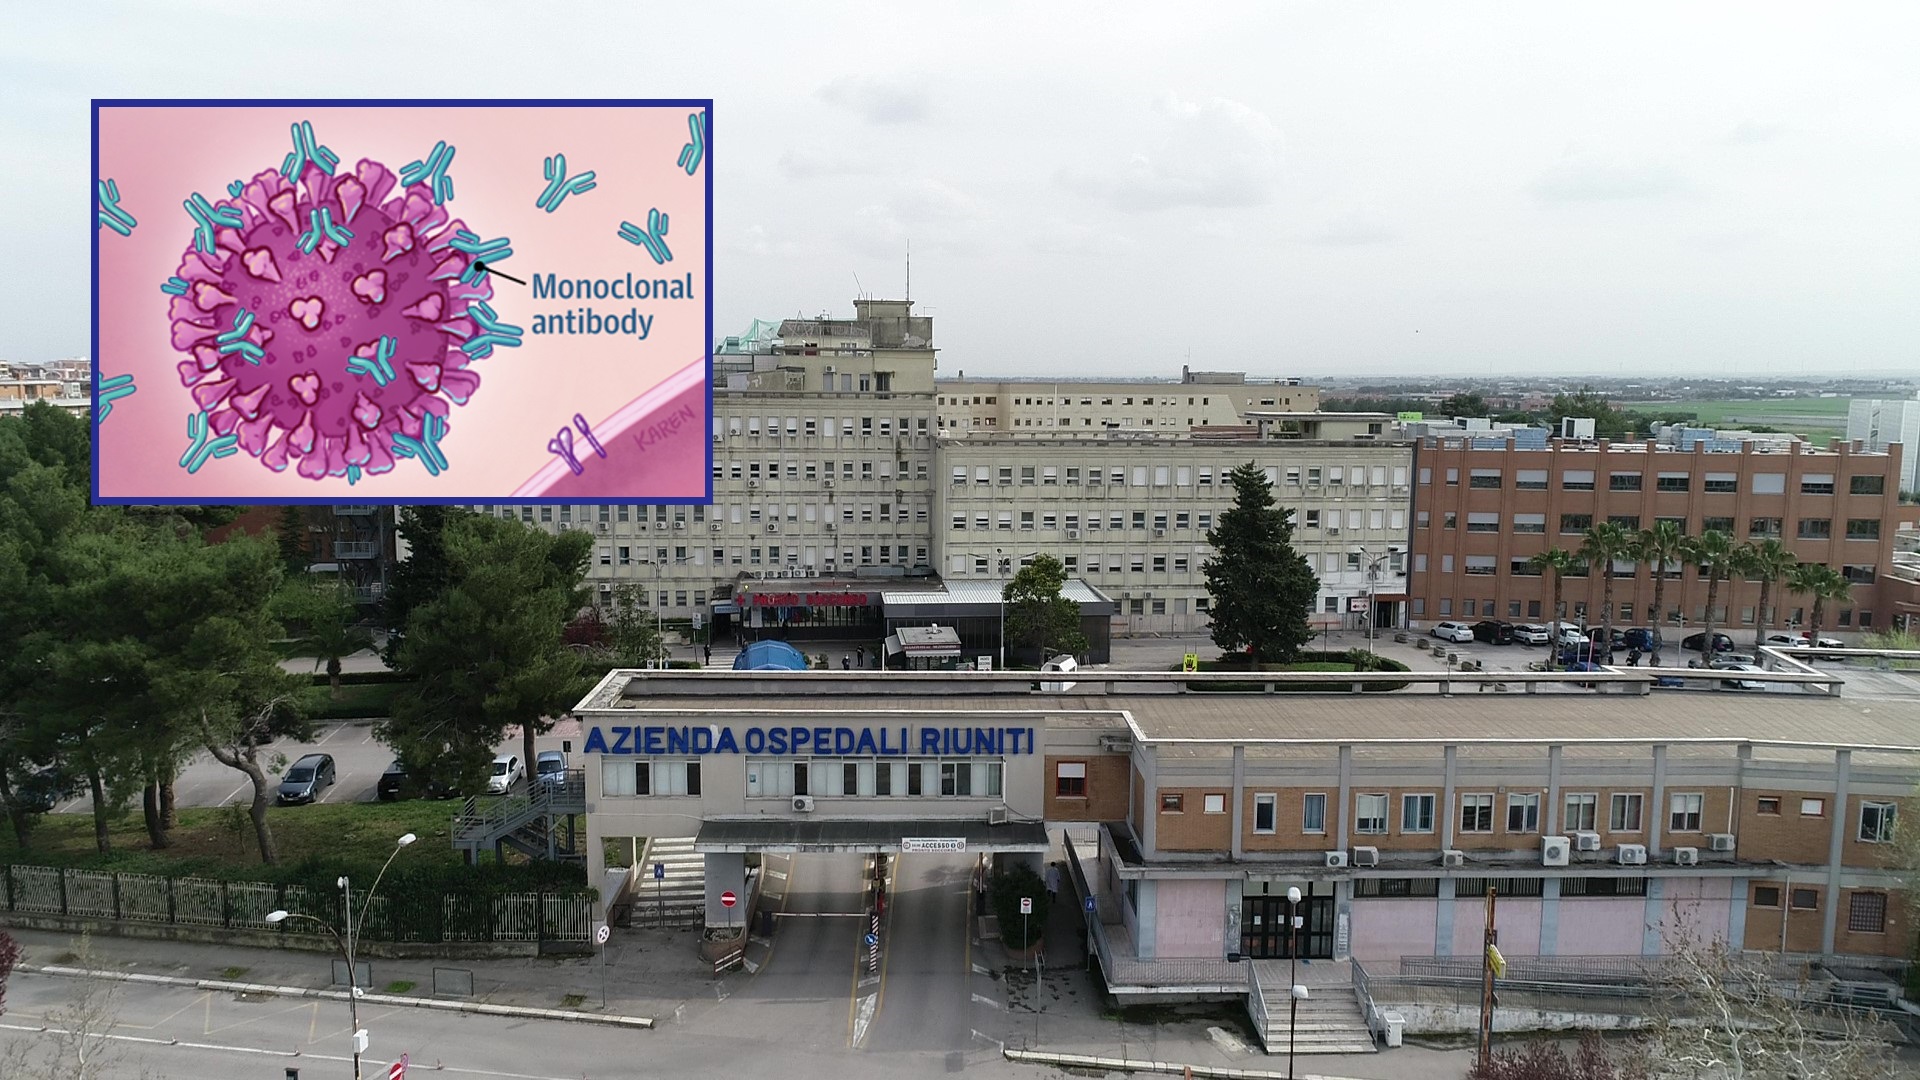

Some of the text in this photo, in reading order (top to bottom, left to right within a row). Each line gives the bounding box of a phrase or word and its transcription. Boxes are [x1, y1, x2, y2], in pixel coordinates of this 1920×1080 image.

[583, 725, 1034, 755] AZIENDA OSPEDALI RIUNITI
